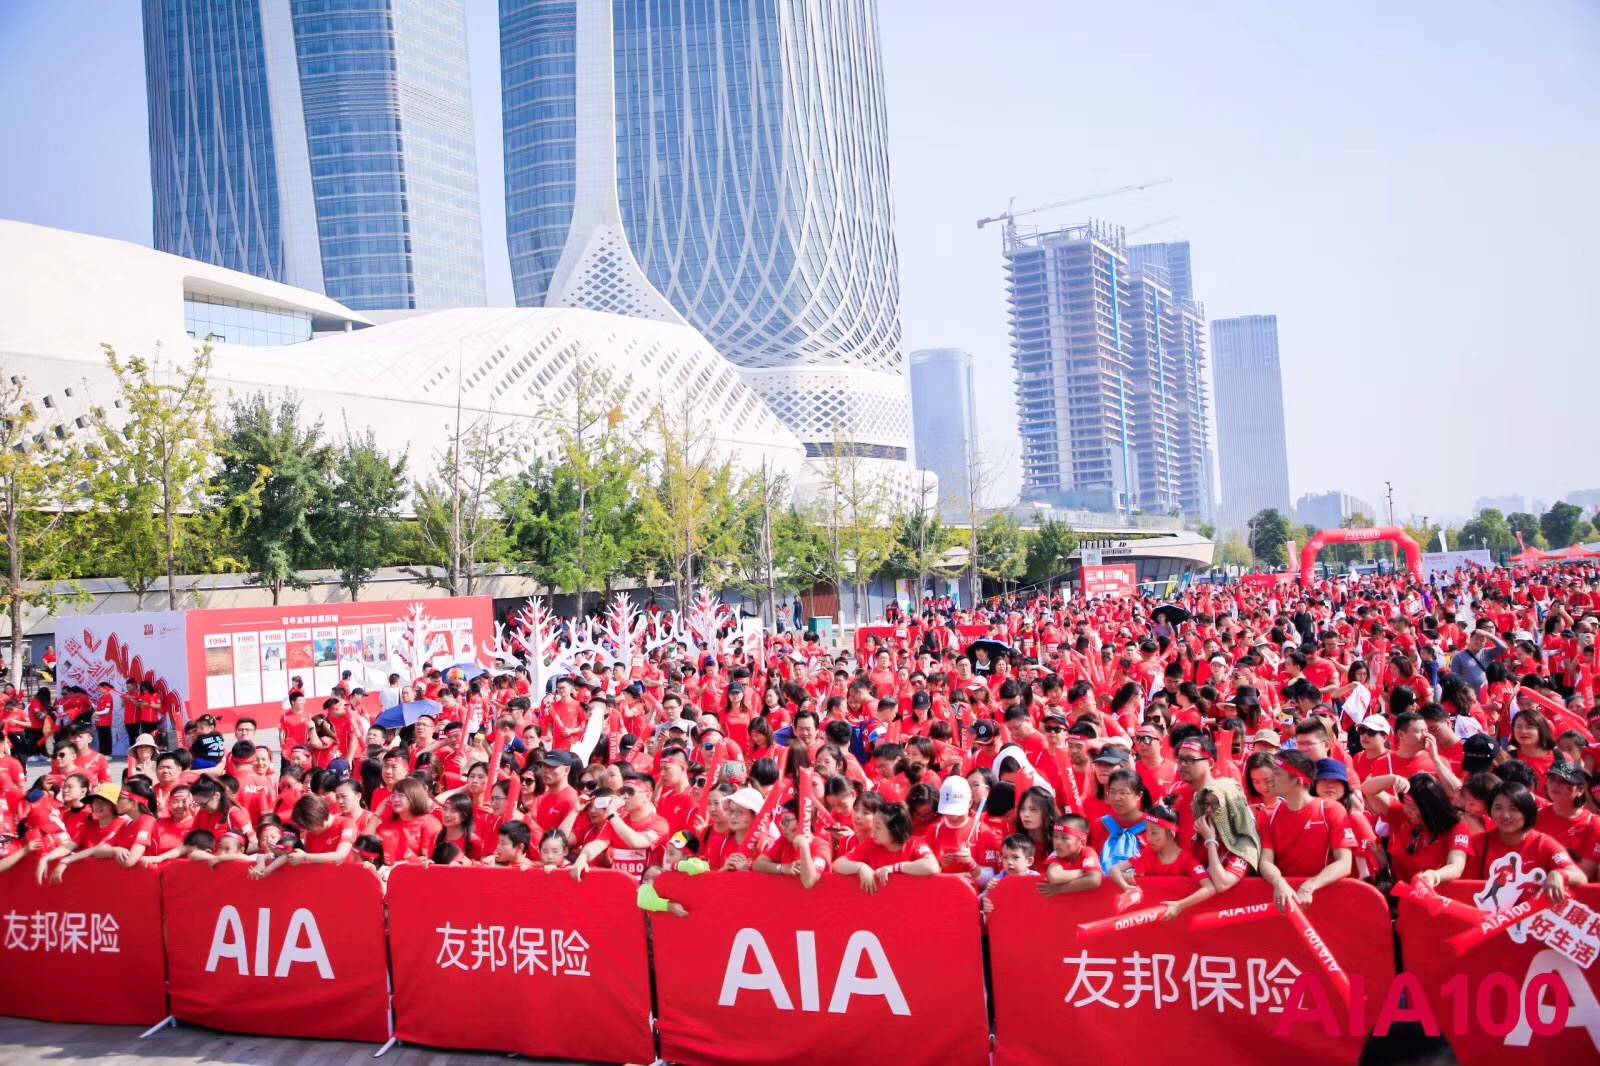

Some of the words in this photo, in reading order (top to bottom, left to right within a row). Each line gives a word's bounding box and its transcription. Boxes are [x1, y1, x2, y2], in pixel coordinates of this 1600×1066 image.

[208, 637, 227, 645] 1994
[237, 635, 255, 643] 1995
[342, 628, 357, 636] 2007
[609, 732, 618, 760] AIA100
[625, 738, 644, 762] AIA100
[615, 863, 645, 873] 1980
[3, 910, 120, 954] 友邦保险
[1481, 901, 1531, 934] AIA100
[205, 904, 335, 980] AIA
[436, 922, 591, 977] 友邦保险
[1304, 927, 1342, 972] AIA100
[1528, 914, 1595, 965] 好生活
[718, 927, 912, 1016] AIA
[1063, 950, 1308, 1015] 友邦保险
